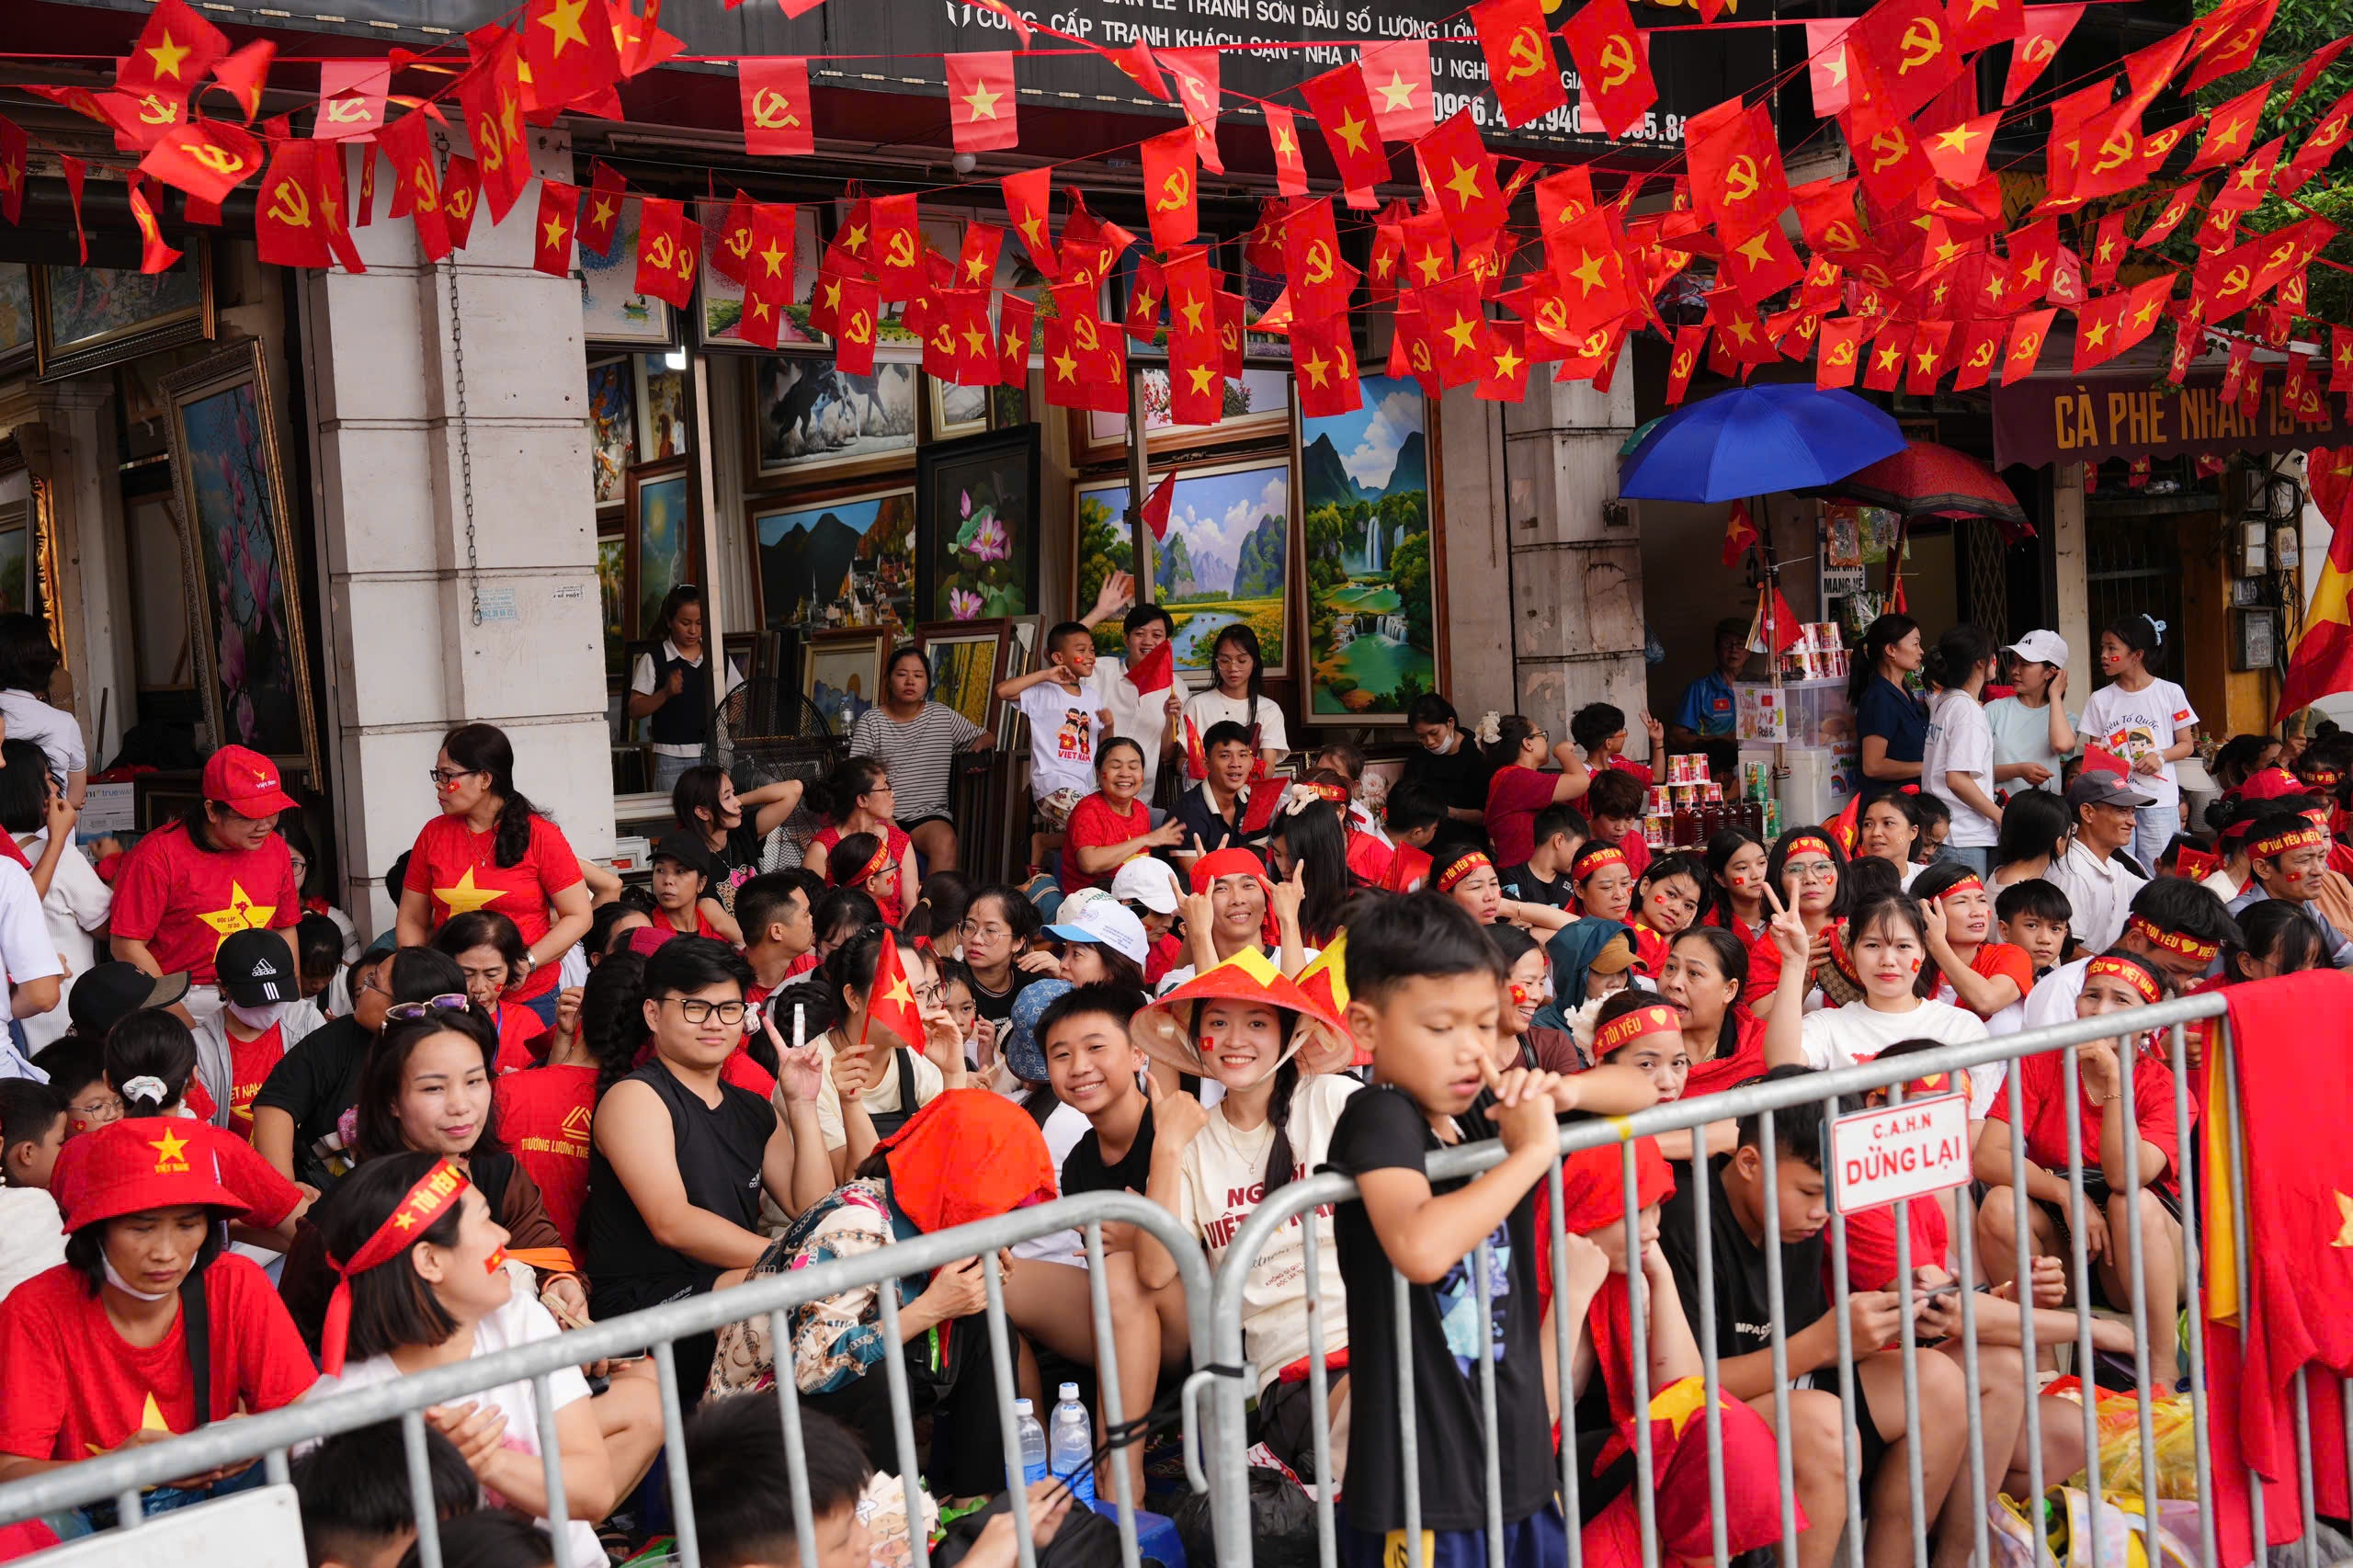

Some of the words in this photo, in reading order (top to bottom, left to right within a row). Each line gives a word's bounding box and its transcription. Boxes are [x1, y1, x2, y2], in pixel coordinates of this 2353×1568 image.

[1051, 8, 1093, 38] CẤP
[1101, 20, 1169, 47] TRANH
[1176, 28, 1243, 54] KHÁCH
[1250, 37, 1288, 62] SẠN
[1188, 0, 1249, 18] TRANH
[1303, 1, 1339, 28] DẦU
[1347, 7, 1371, 33] SỐ
[1379, 16, 1438, 40] LƯỢNG
[1445, 18, 1477, 44] LỚN
[2054, 385, 2098, 449] CÀ
[1454, 858, 1469, 872] YÊU
[252, 968, 277, 977] adidas
[2120, 965, 2141, 985] VIỆT
[1604, 1028, 1619, 1047] TÔI
[1620, 1017, 1643, 1039] YÊU
[1872, 1112, 1932, 1140] C.A.H.N
[1923, 1135, 1961, 1170] LẠI
